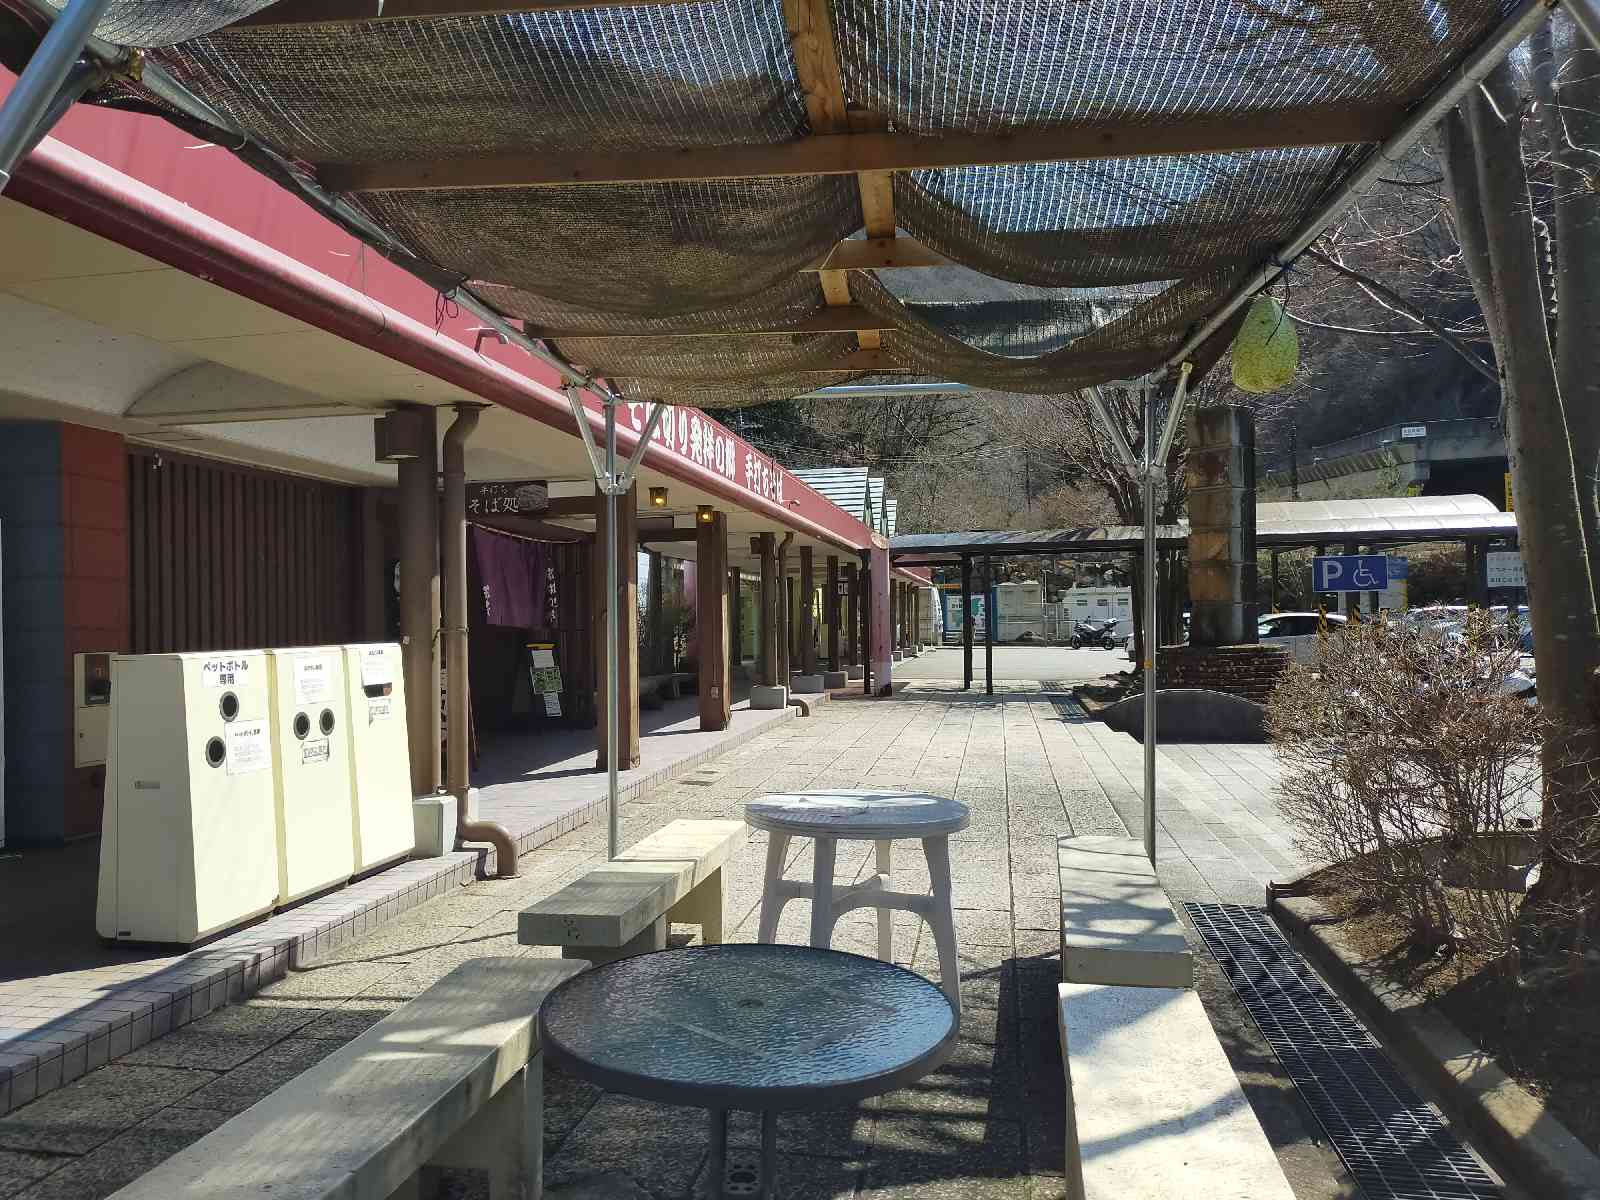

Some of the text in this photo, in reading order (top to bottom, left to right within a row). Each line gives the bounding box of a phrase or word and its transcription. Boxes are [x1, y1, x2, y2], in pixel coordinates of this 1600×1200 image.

[468, 498, 520, 514] そば処
[1323, 561, 1343, 588] P
[203, 660, 249, 672] ペットボトル
[219, 673, 235, 685] 専用
